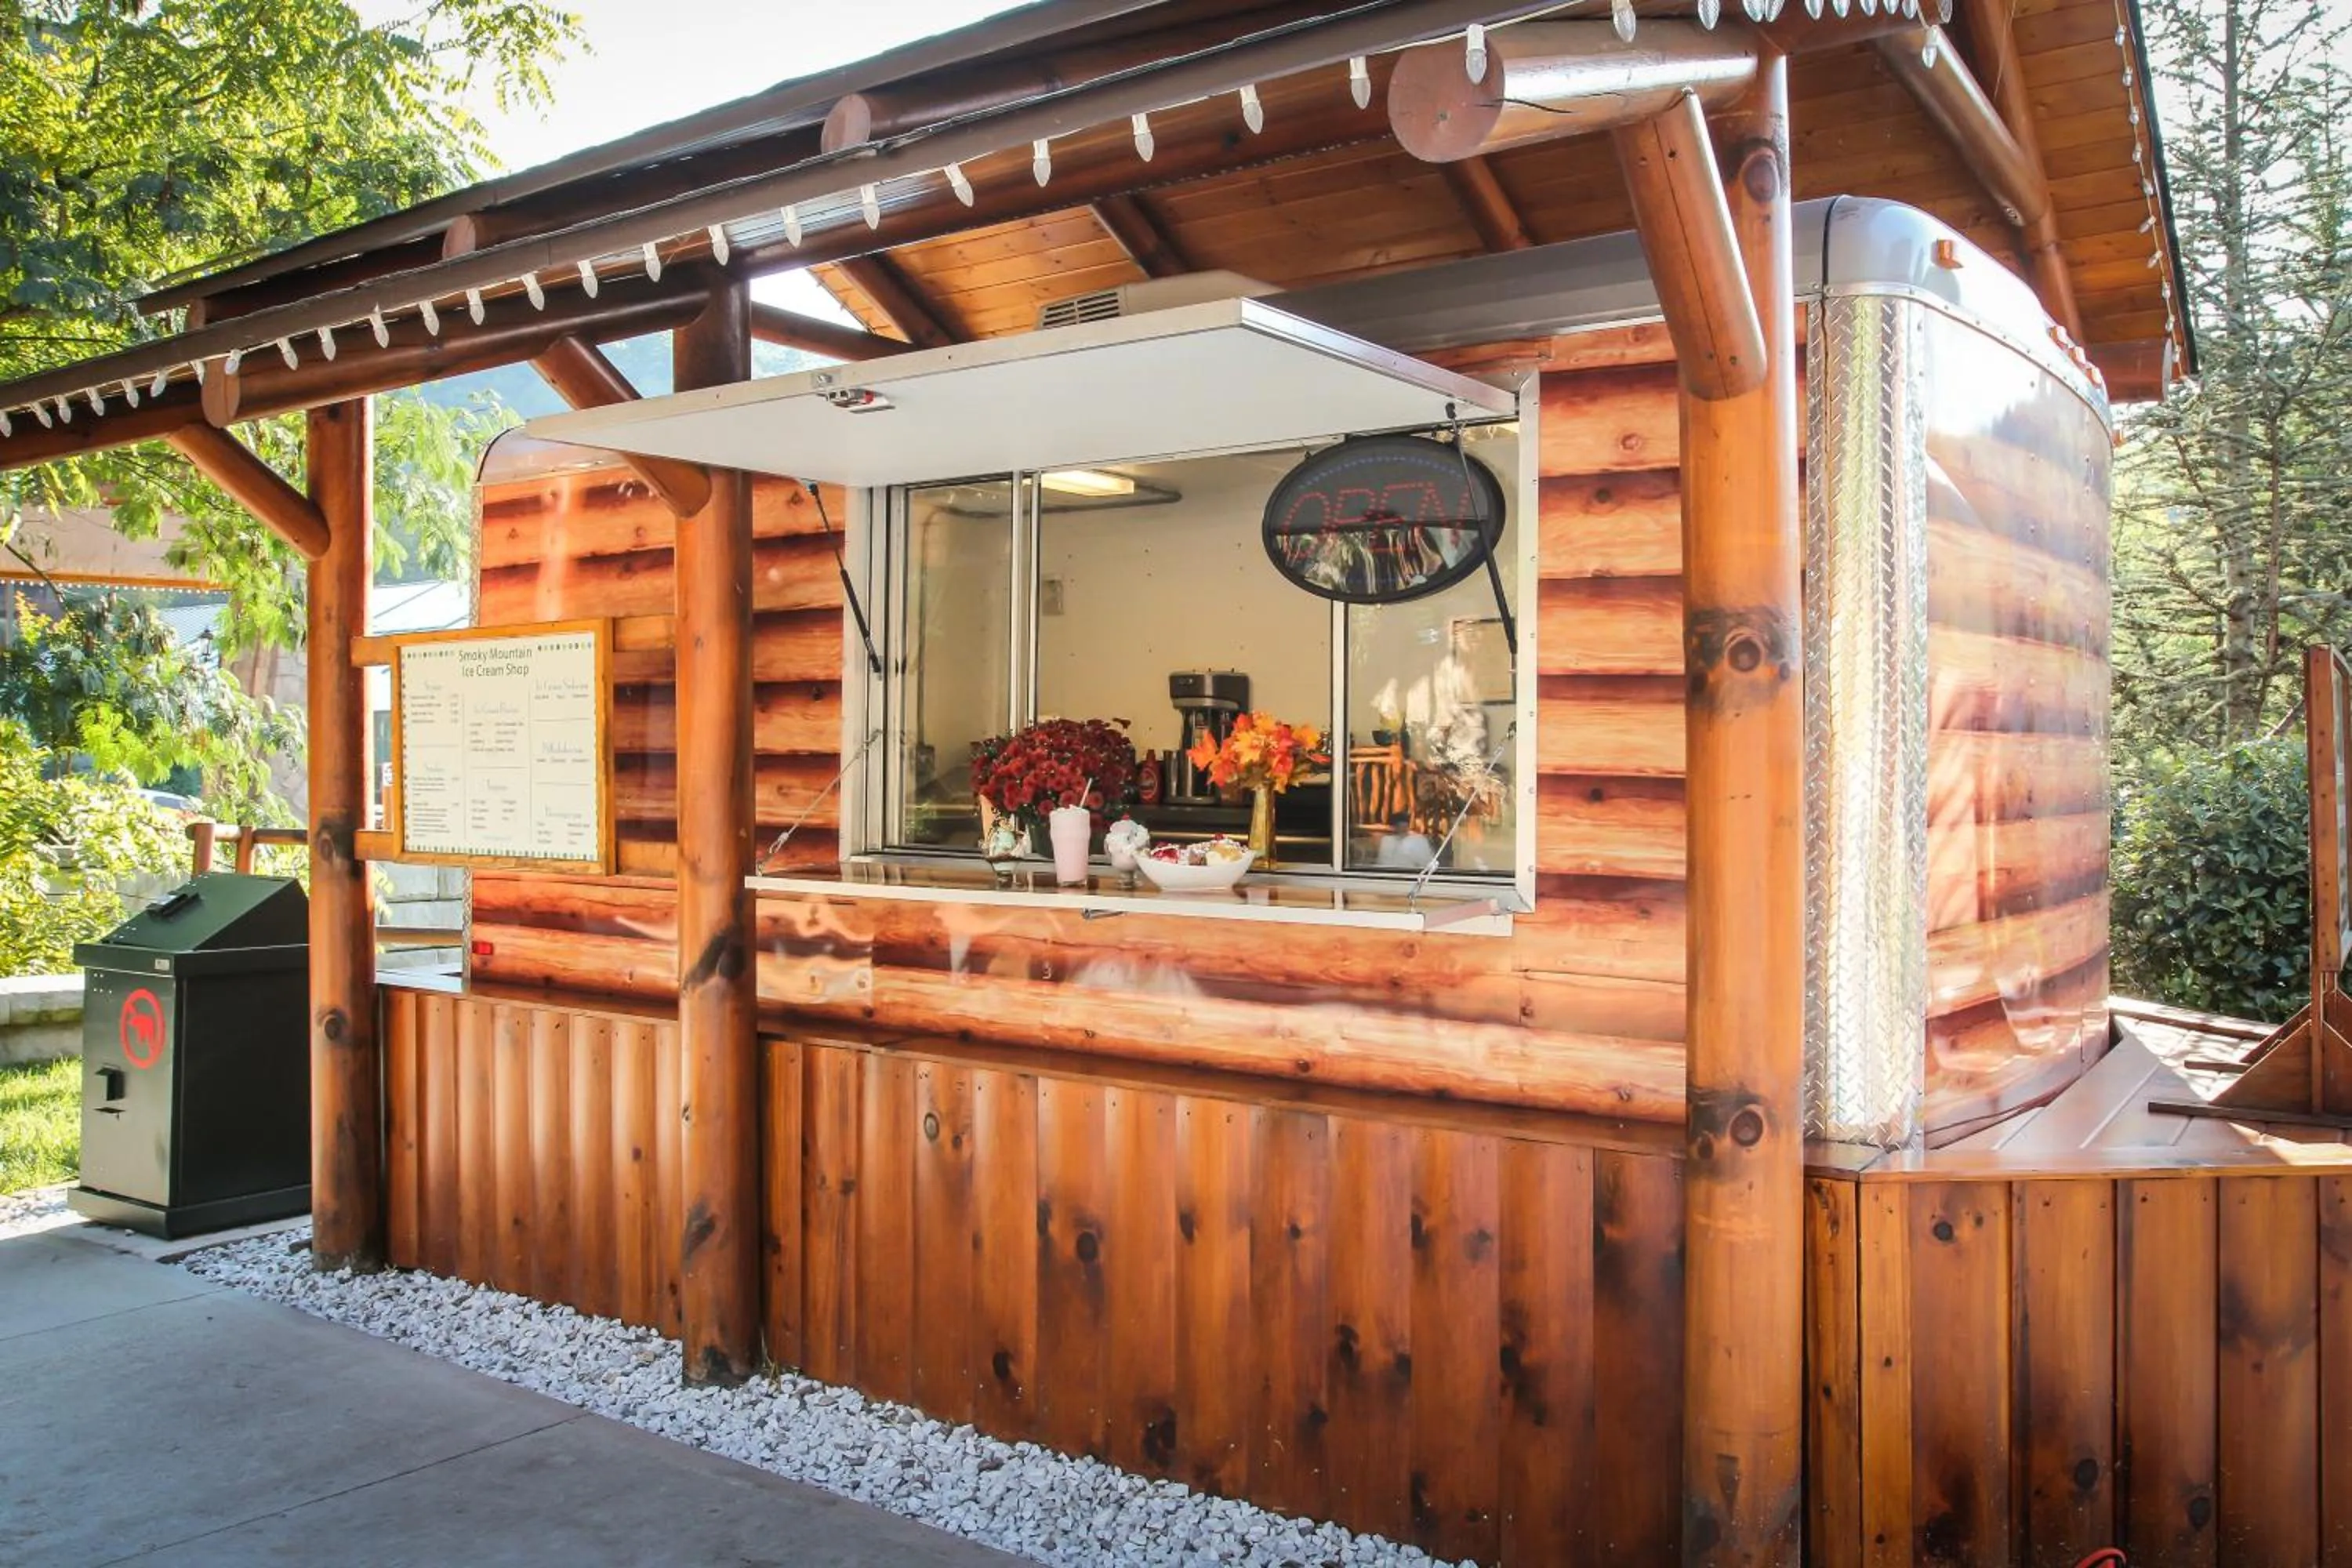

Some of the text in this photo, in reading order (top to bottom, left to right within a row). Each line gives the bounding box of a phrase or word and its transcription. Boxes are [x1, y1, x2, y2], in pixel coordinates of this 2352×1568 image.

[1282, 476, 1477, 559] OPEN
[458, 647, 532, 664] Smoky Mountain
[462, 663, 529, 677] Ice Cream Shop
